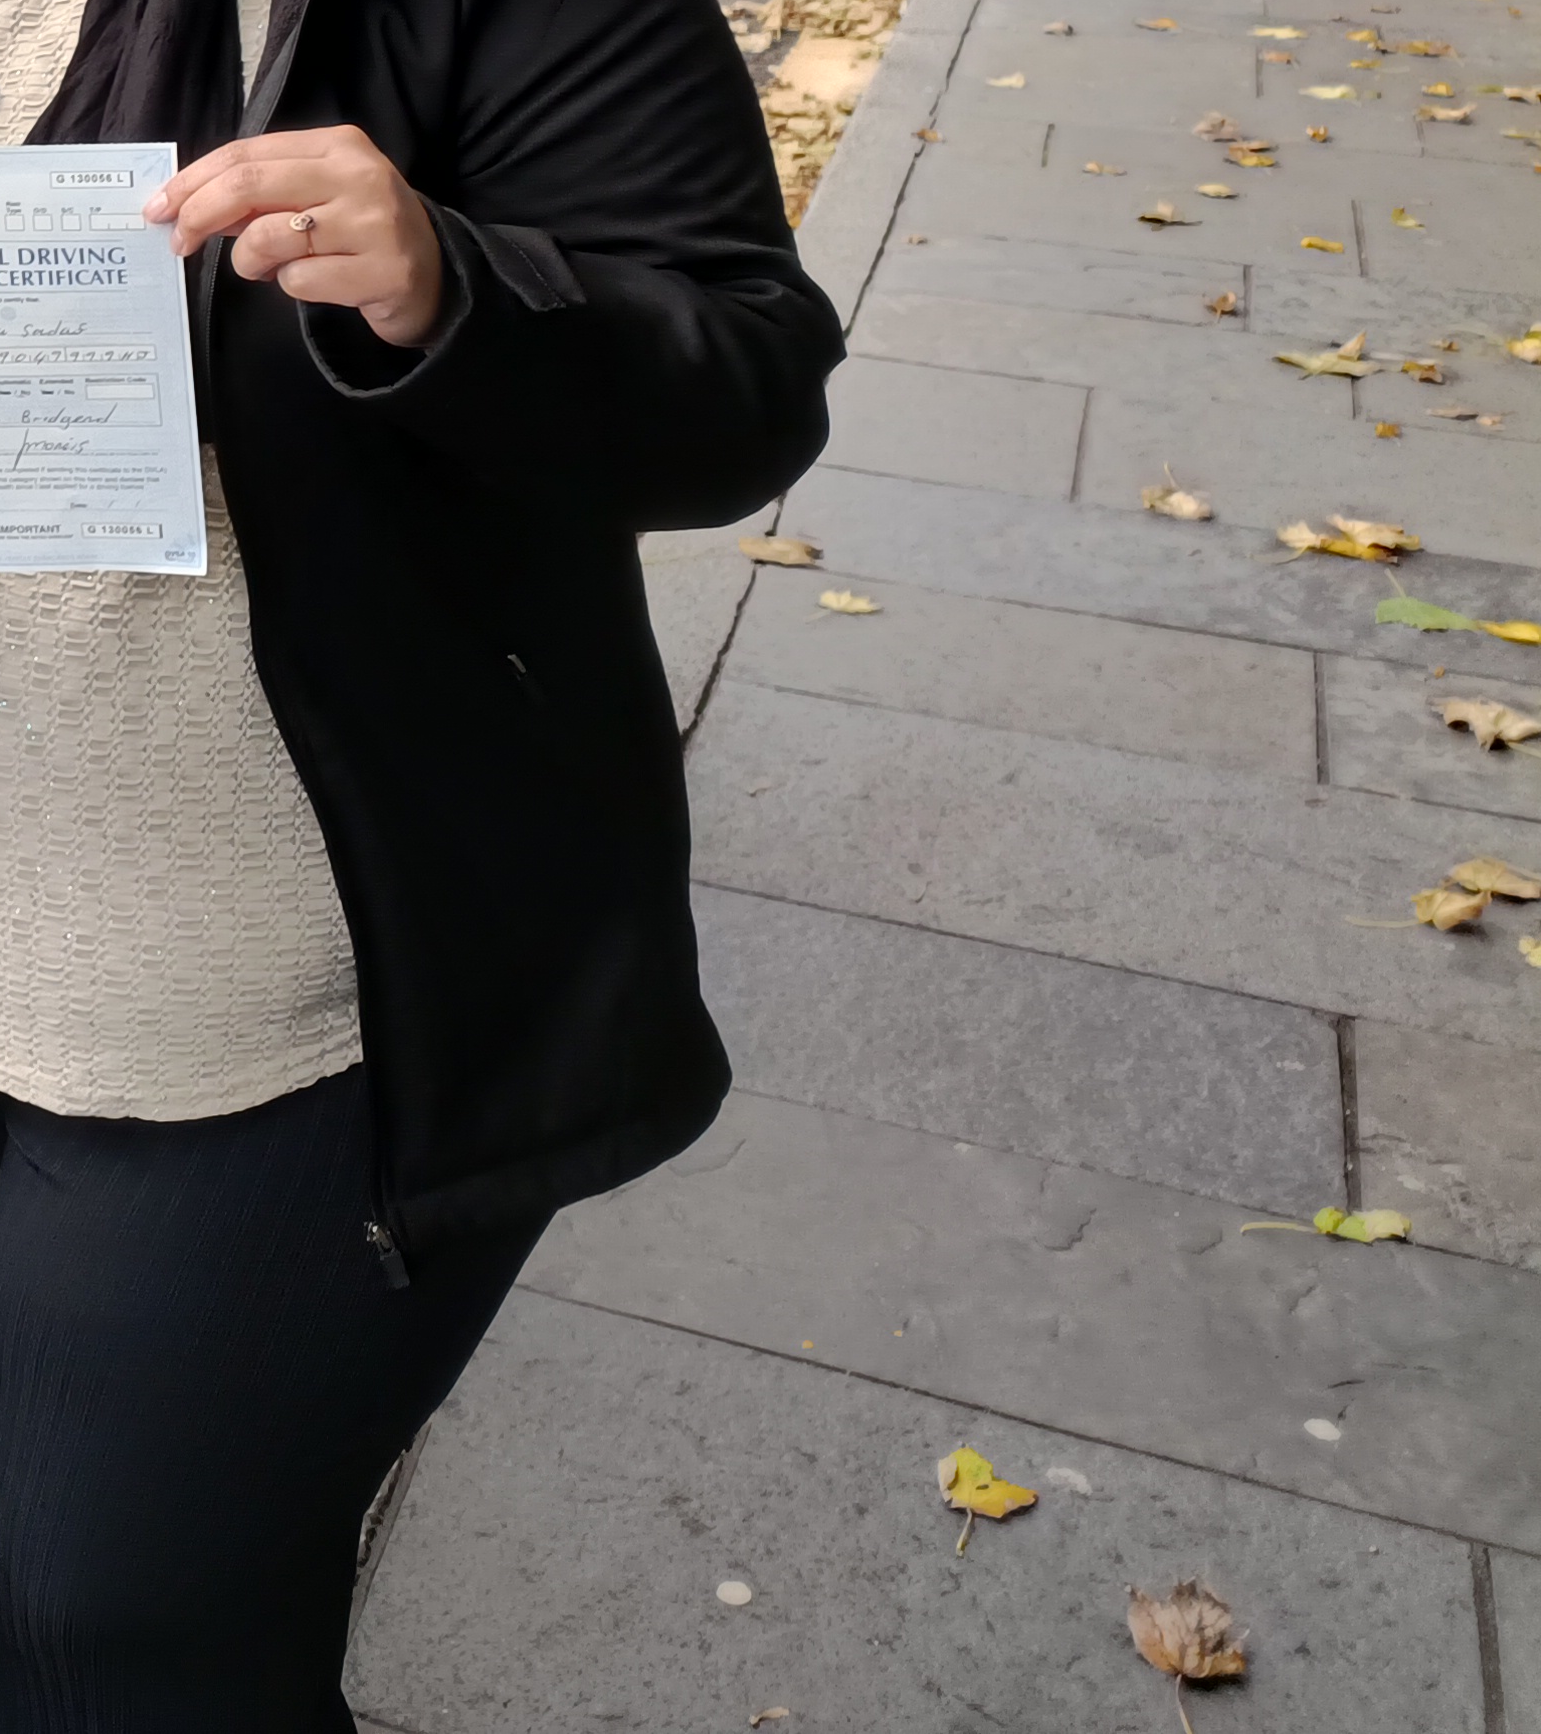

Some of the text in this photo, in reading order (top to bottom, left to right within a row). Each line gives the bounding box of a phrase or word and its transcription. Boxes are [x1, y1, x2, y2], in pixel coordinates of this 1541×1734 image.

[55, 173, 66, 185] G
[116, 173, 124, 184] L
[17, 247, 126, 265] DRIVING
